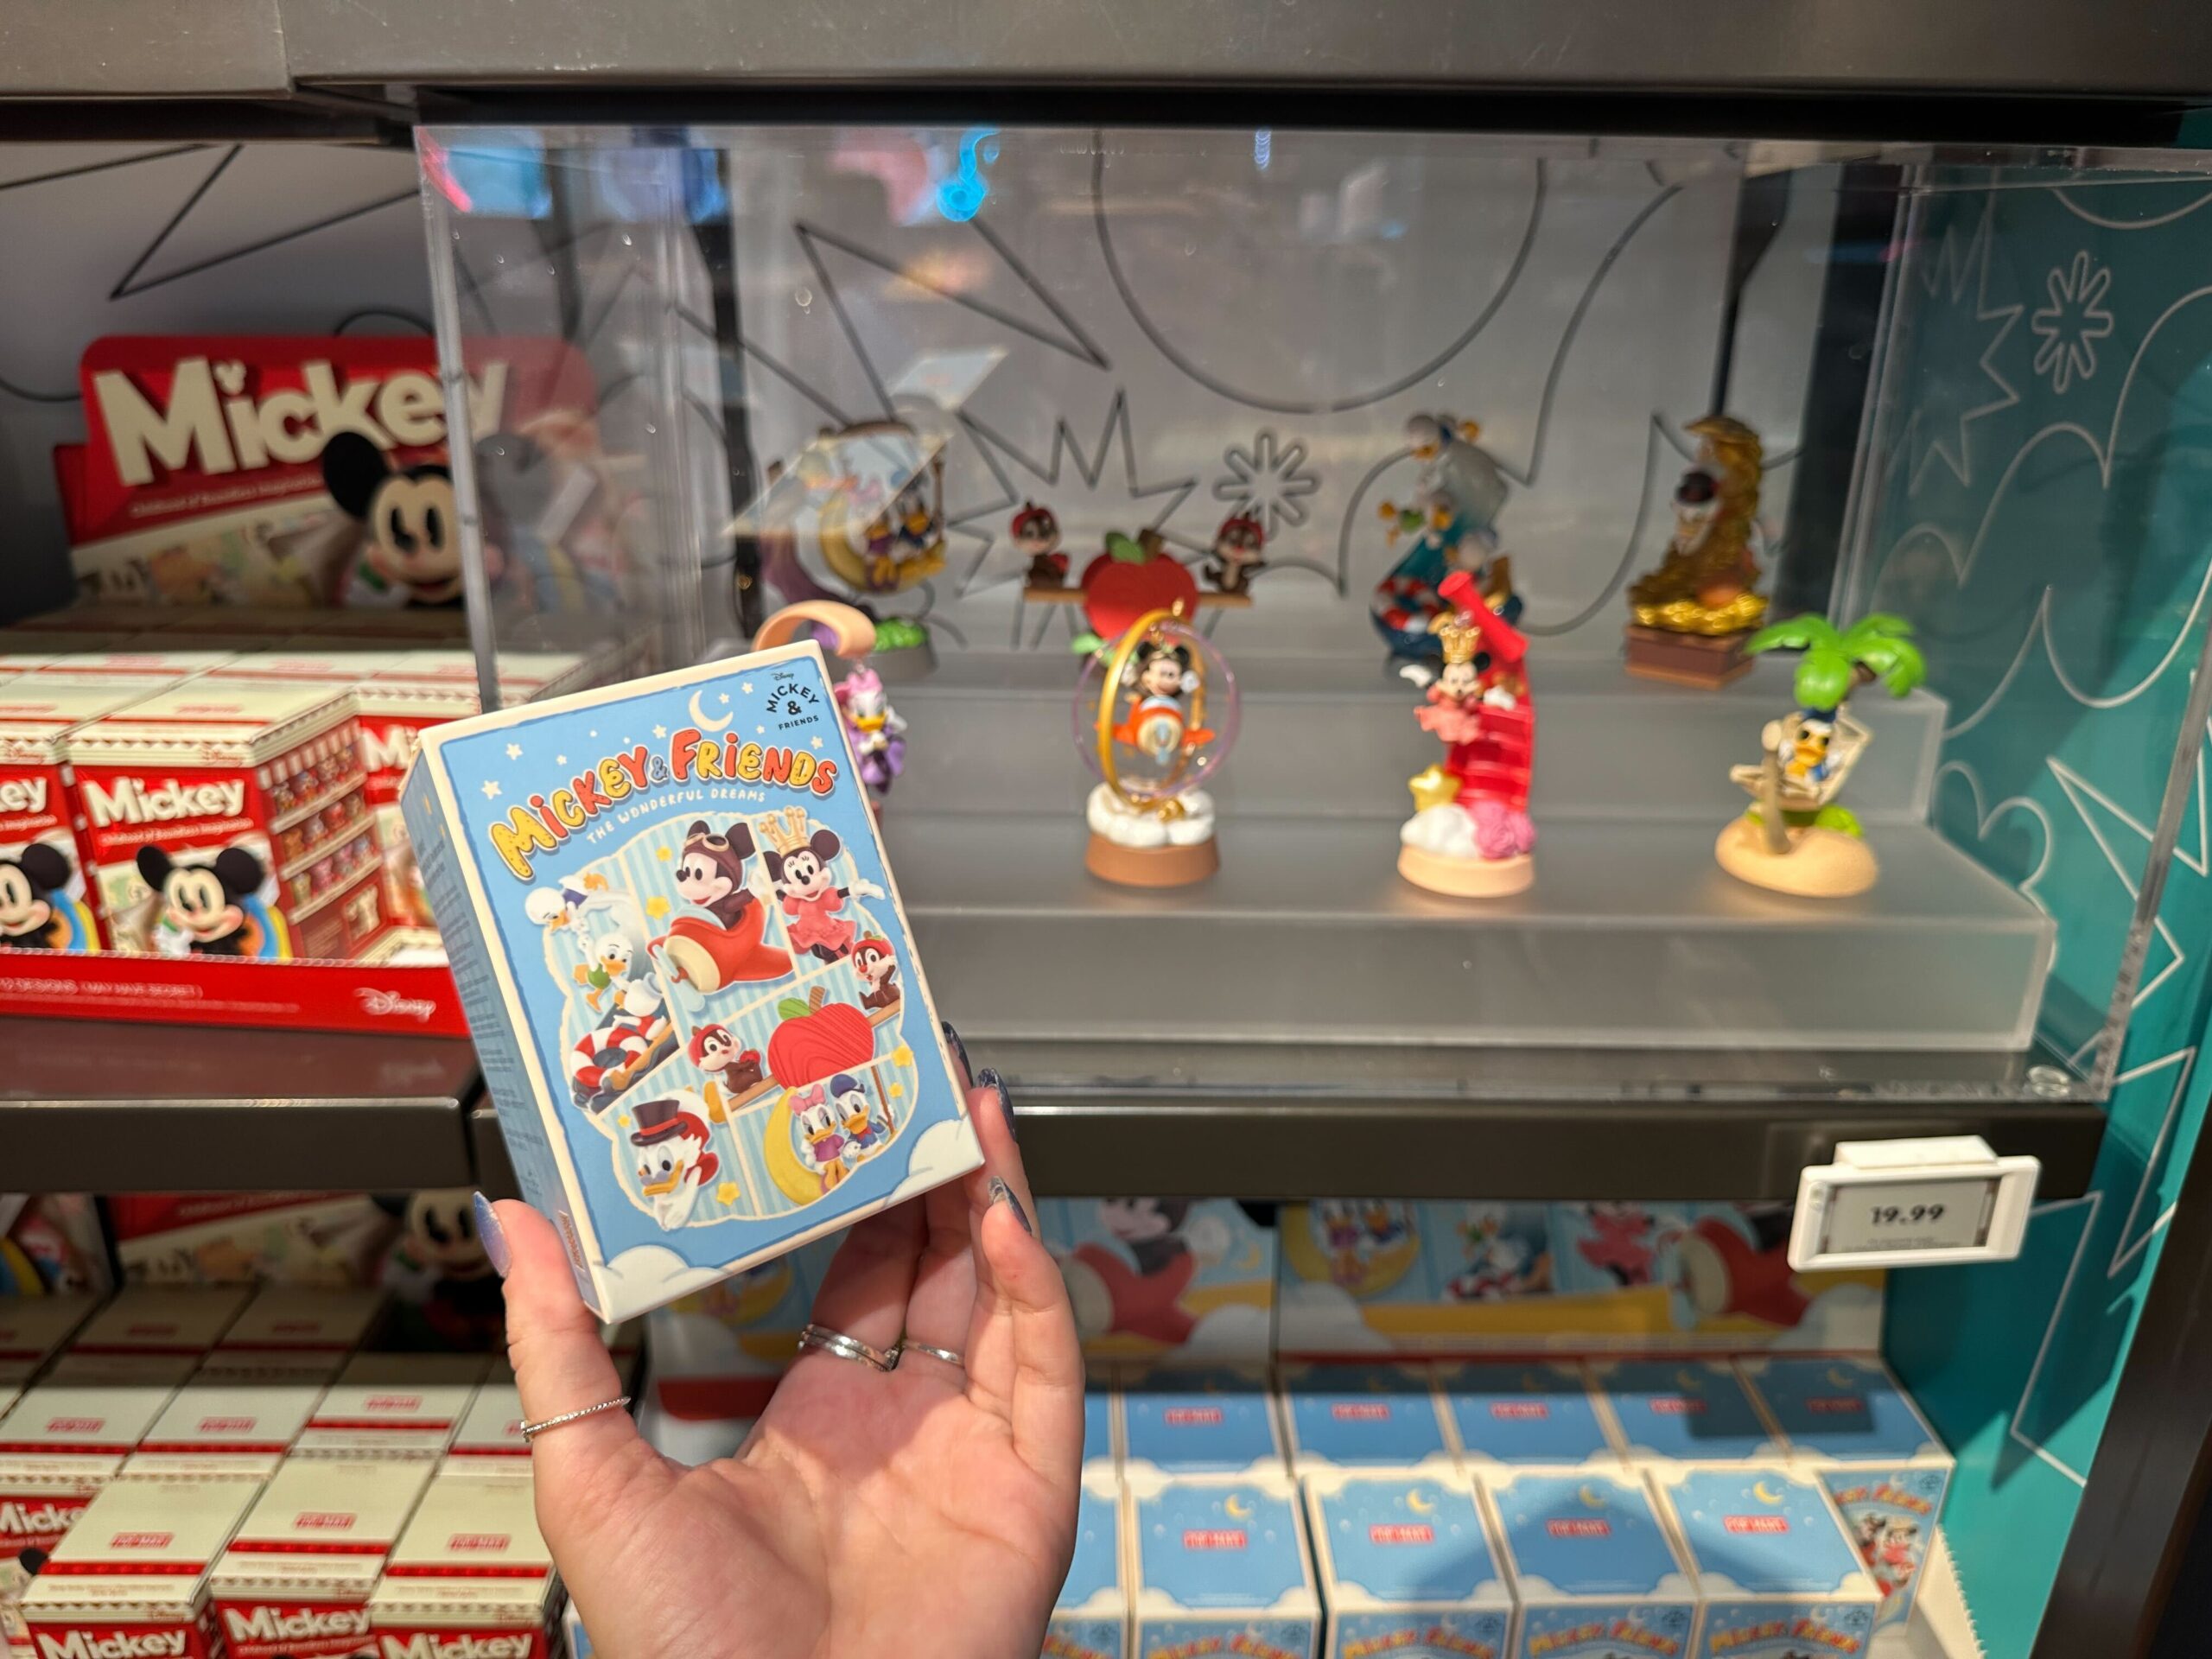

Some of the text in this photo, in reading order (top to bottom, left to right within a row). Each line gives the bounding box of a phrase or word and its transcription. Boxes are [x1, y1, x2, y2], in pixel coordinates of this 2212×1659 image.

[94, 356, 509, 486] Mickey
[766, 683, 820, 713] MICKEY
[787, 701, 802, 715] &
[779, 715, 819, 730] FRIENDS
[651, 755, 669, 781] &
[84, 776, 245, 828] Mickey
[587, 787, 766, 843] THE WONDERFUL DREAMS
[353, 987, 436, 1023] Disney
[1871, 1203, 1945, 1227] 19.99
[223, 1605, 372, 1643] Mickey
[35, 1630, 187, 1659] Mickey
[379, 1632, 533, 1659] Mickey
